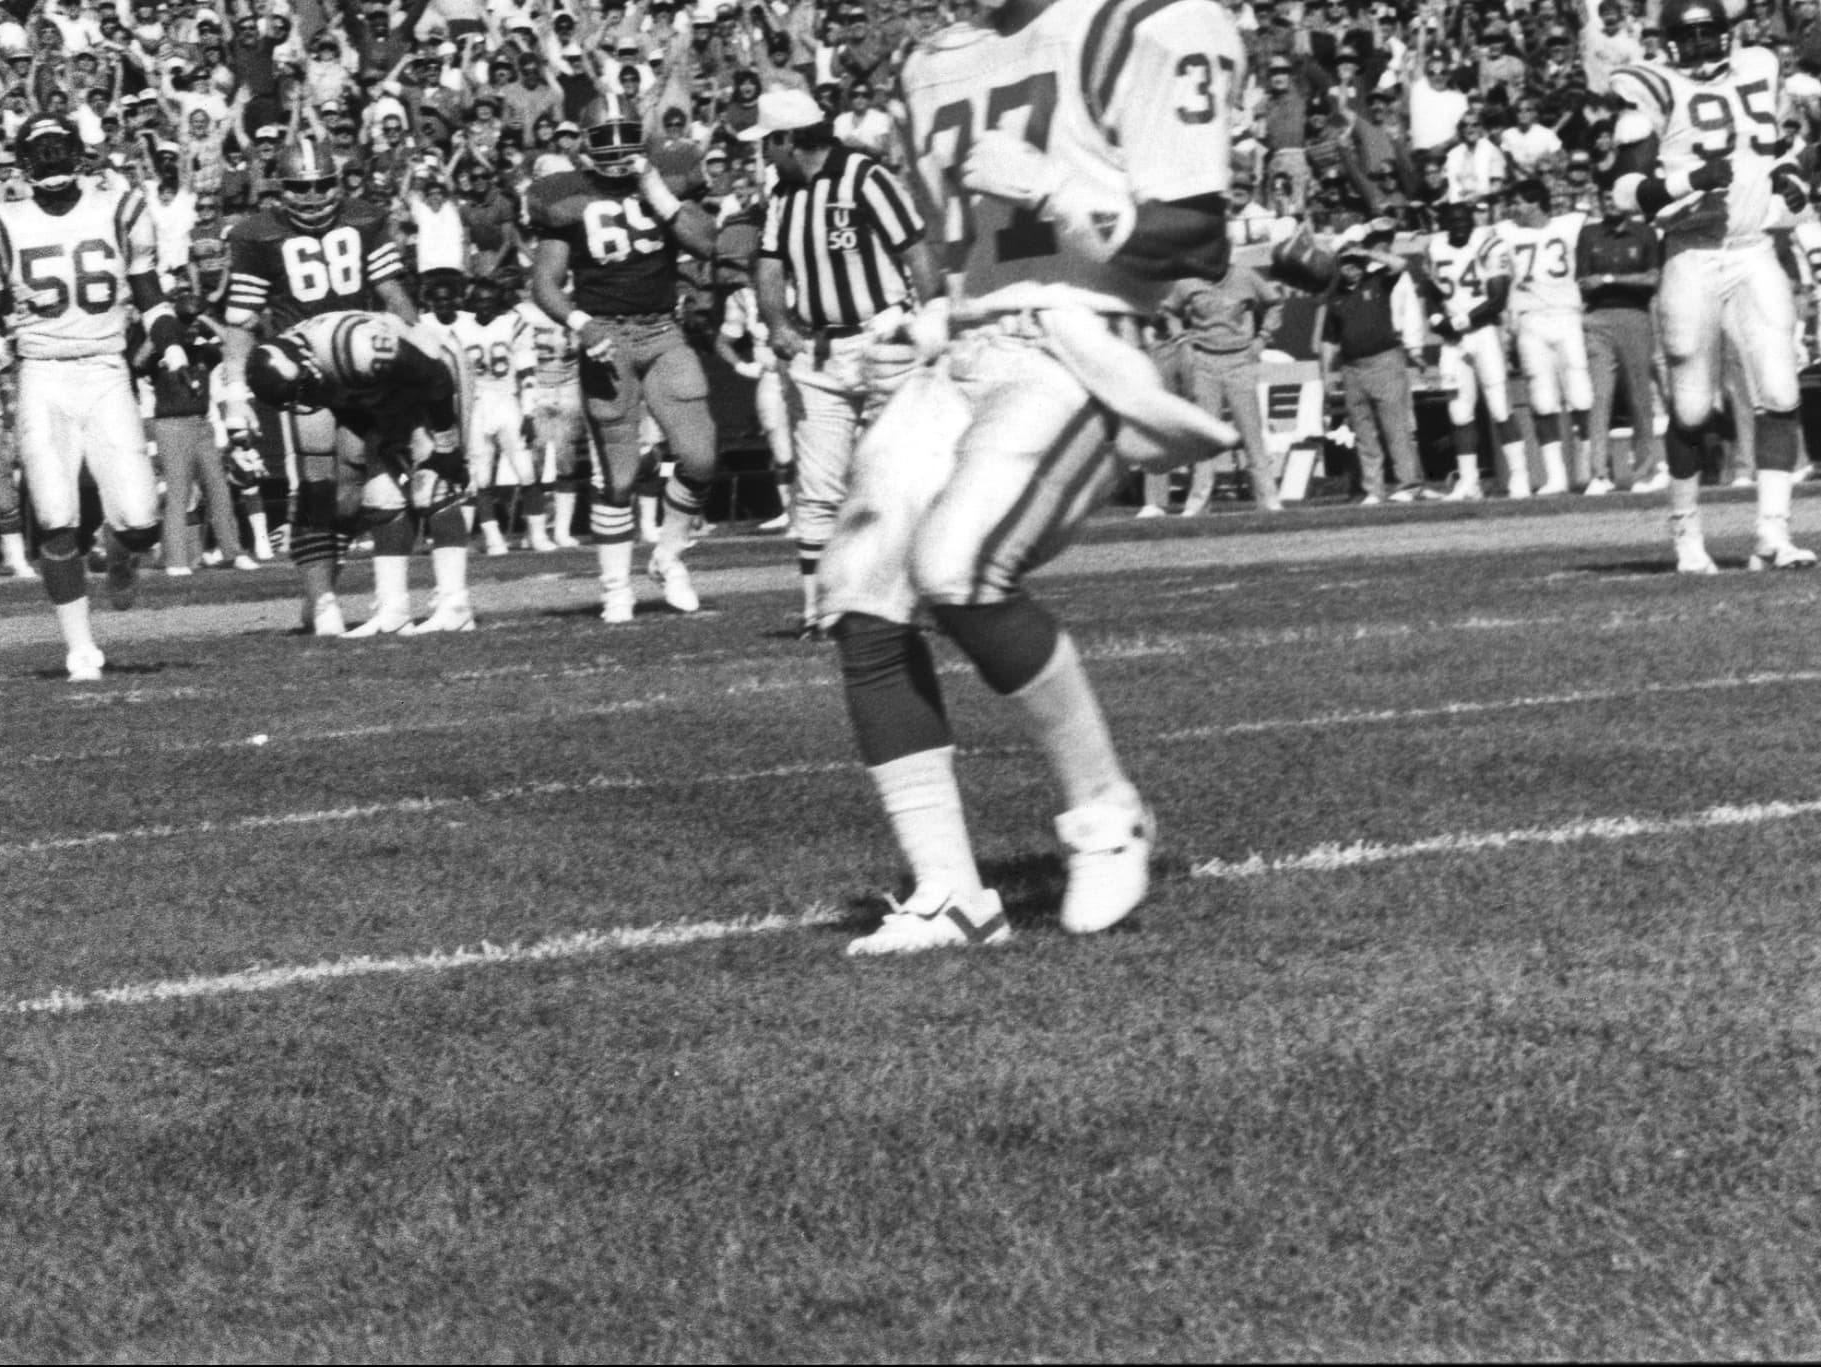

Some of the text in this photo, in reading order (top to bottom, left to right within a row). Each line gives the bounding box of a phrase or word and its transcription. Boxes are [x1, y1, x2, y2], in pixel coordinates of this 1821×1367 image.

[1688, 79, 1782, 161] 95
[828, 230, 858, 250] 50
[833, 208, 850, 229] U
[19, 238, 118, 318] 56
[282, 226, 363, 303] 68
[1436, 260, 1485, 300] 54
[1515, 238, 1569, 283] 73
